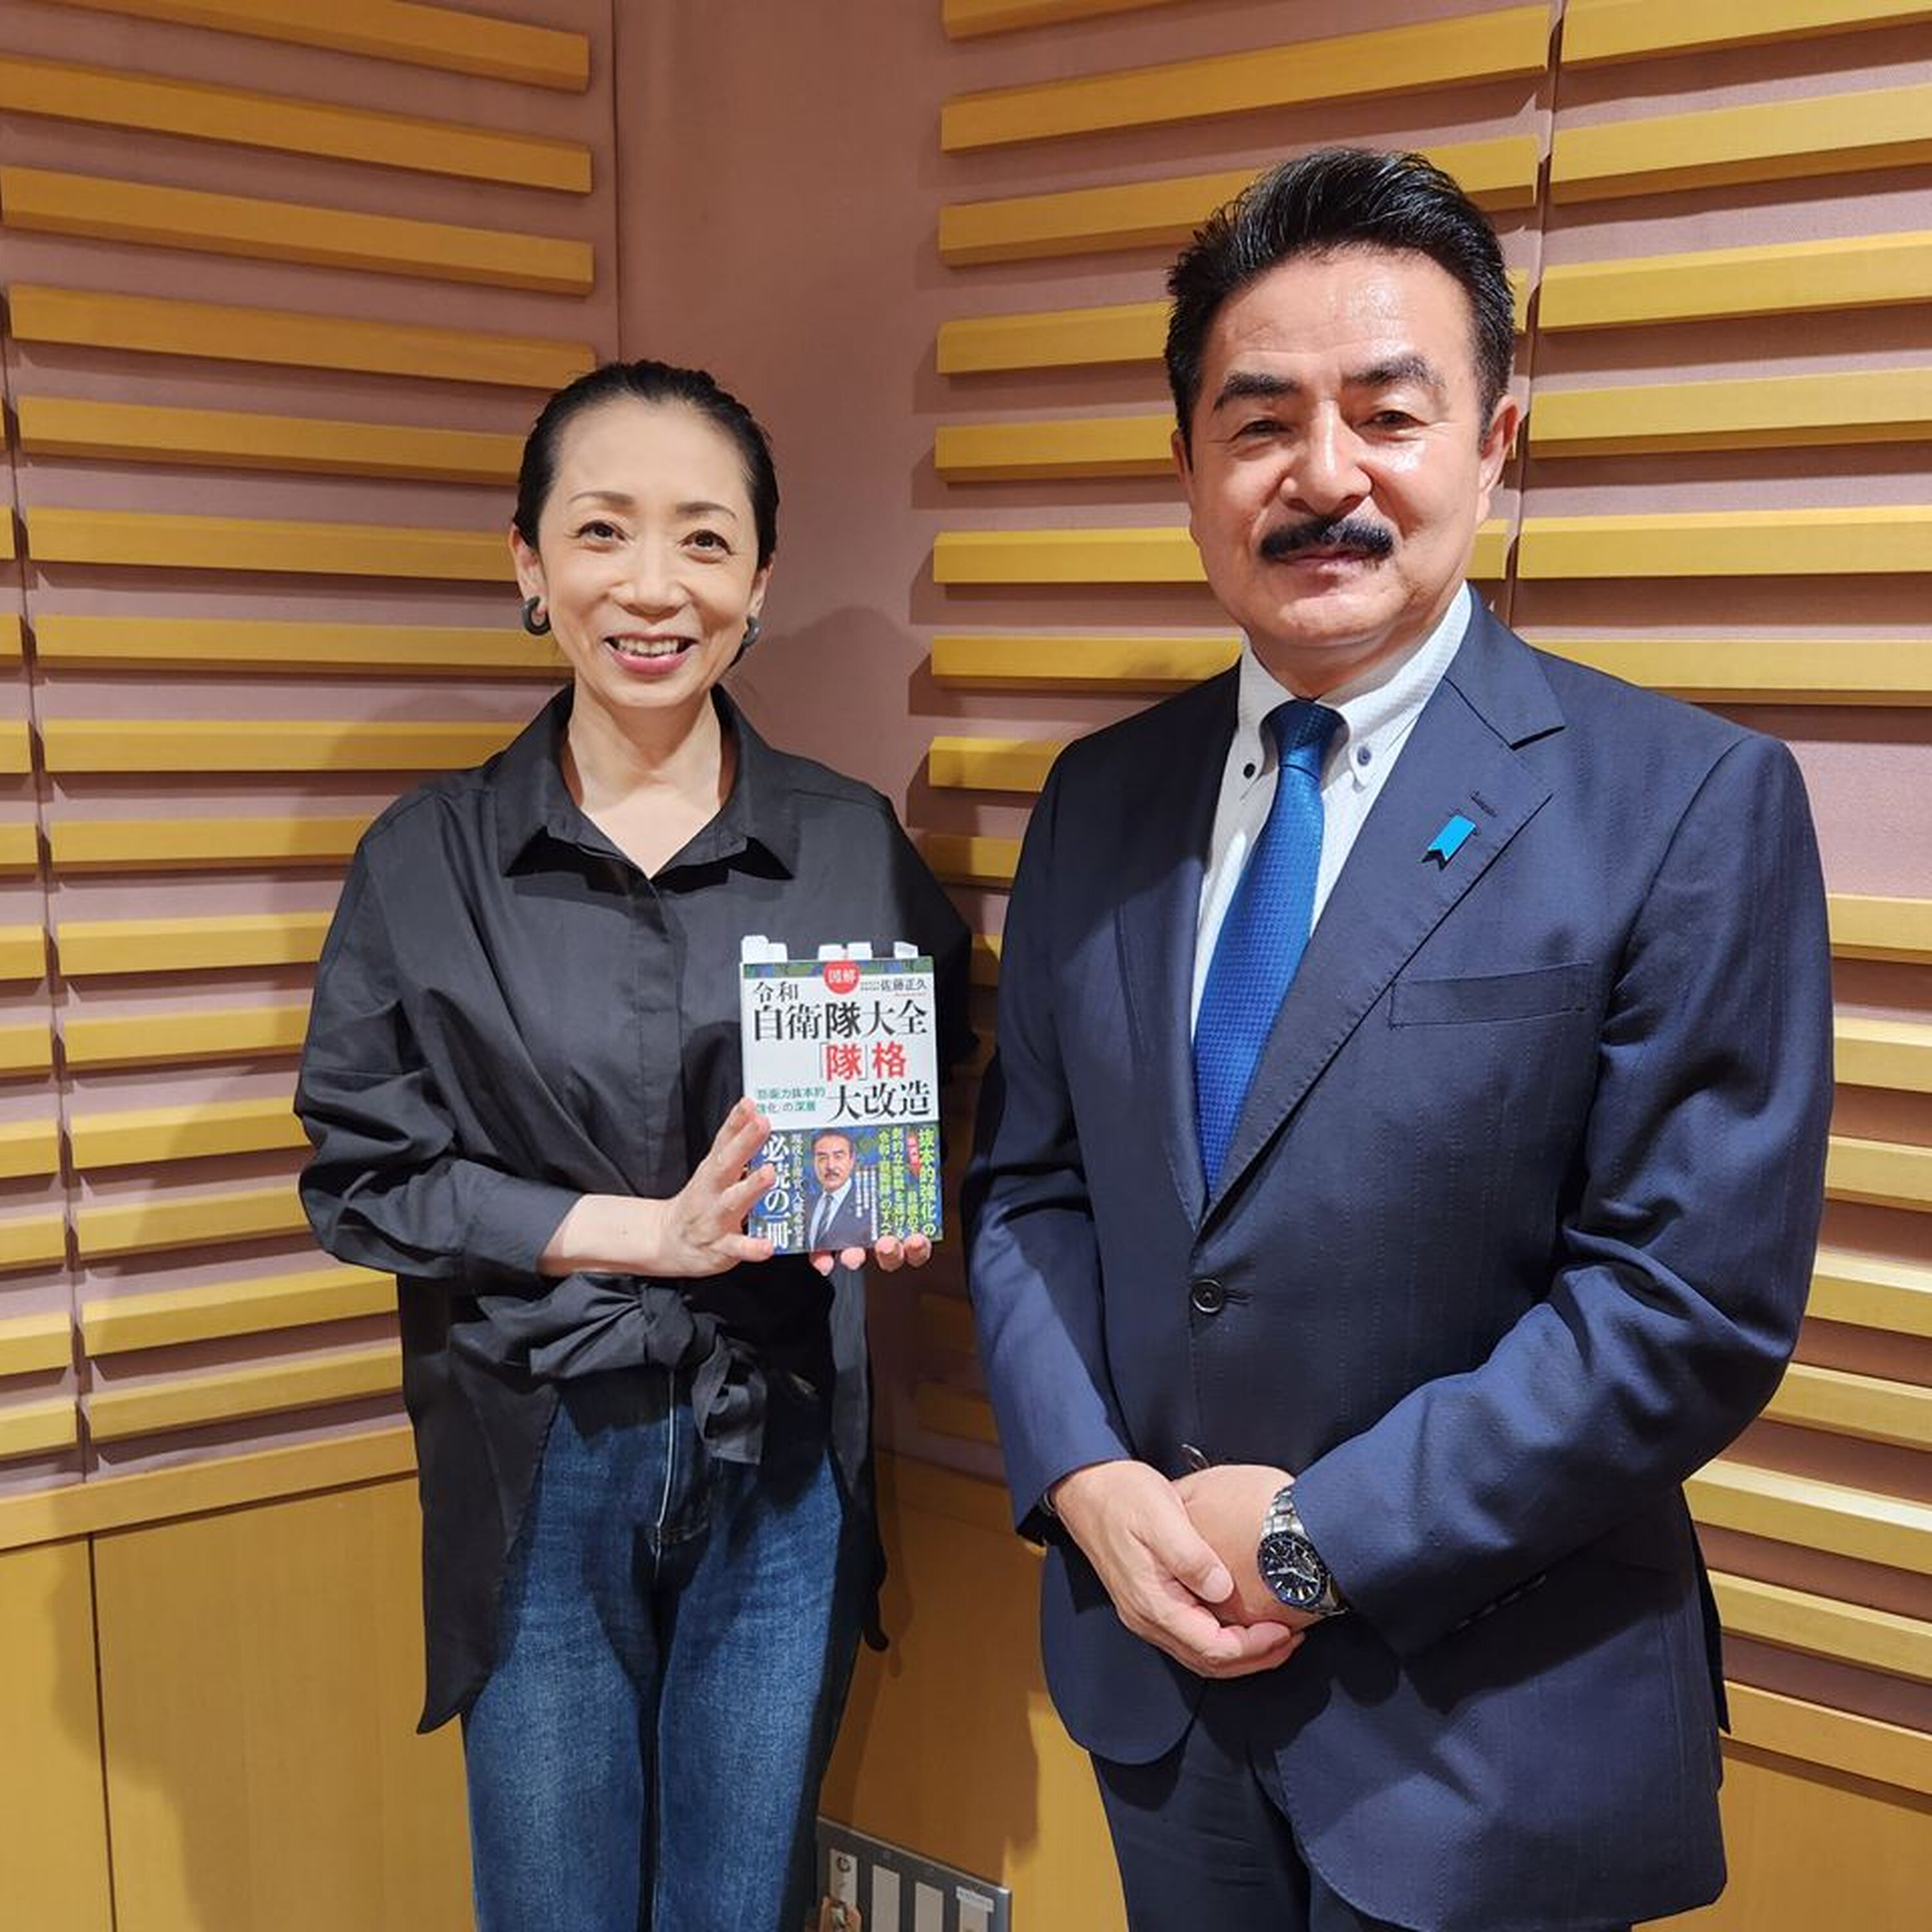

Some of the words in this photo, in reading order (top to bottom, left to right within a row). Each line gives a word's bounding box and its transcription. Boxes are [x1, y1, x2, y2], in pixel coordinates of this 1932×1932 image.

[754, 980, 799, 1002] 令和
[880, 978, 927, 992] 佐藤正久
[754, 999, 927, 1041] 自衛隊大全
[828, 1080, 931, 1122] 大改造
